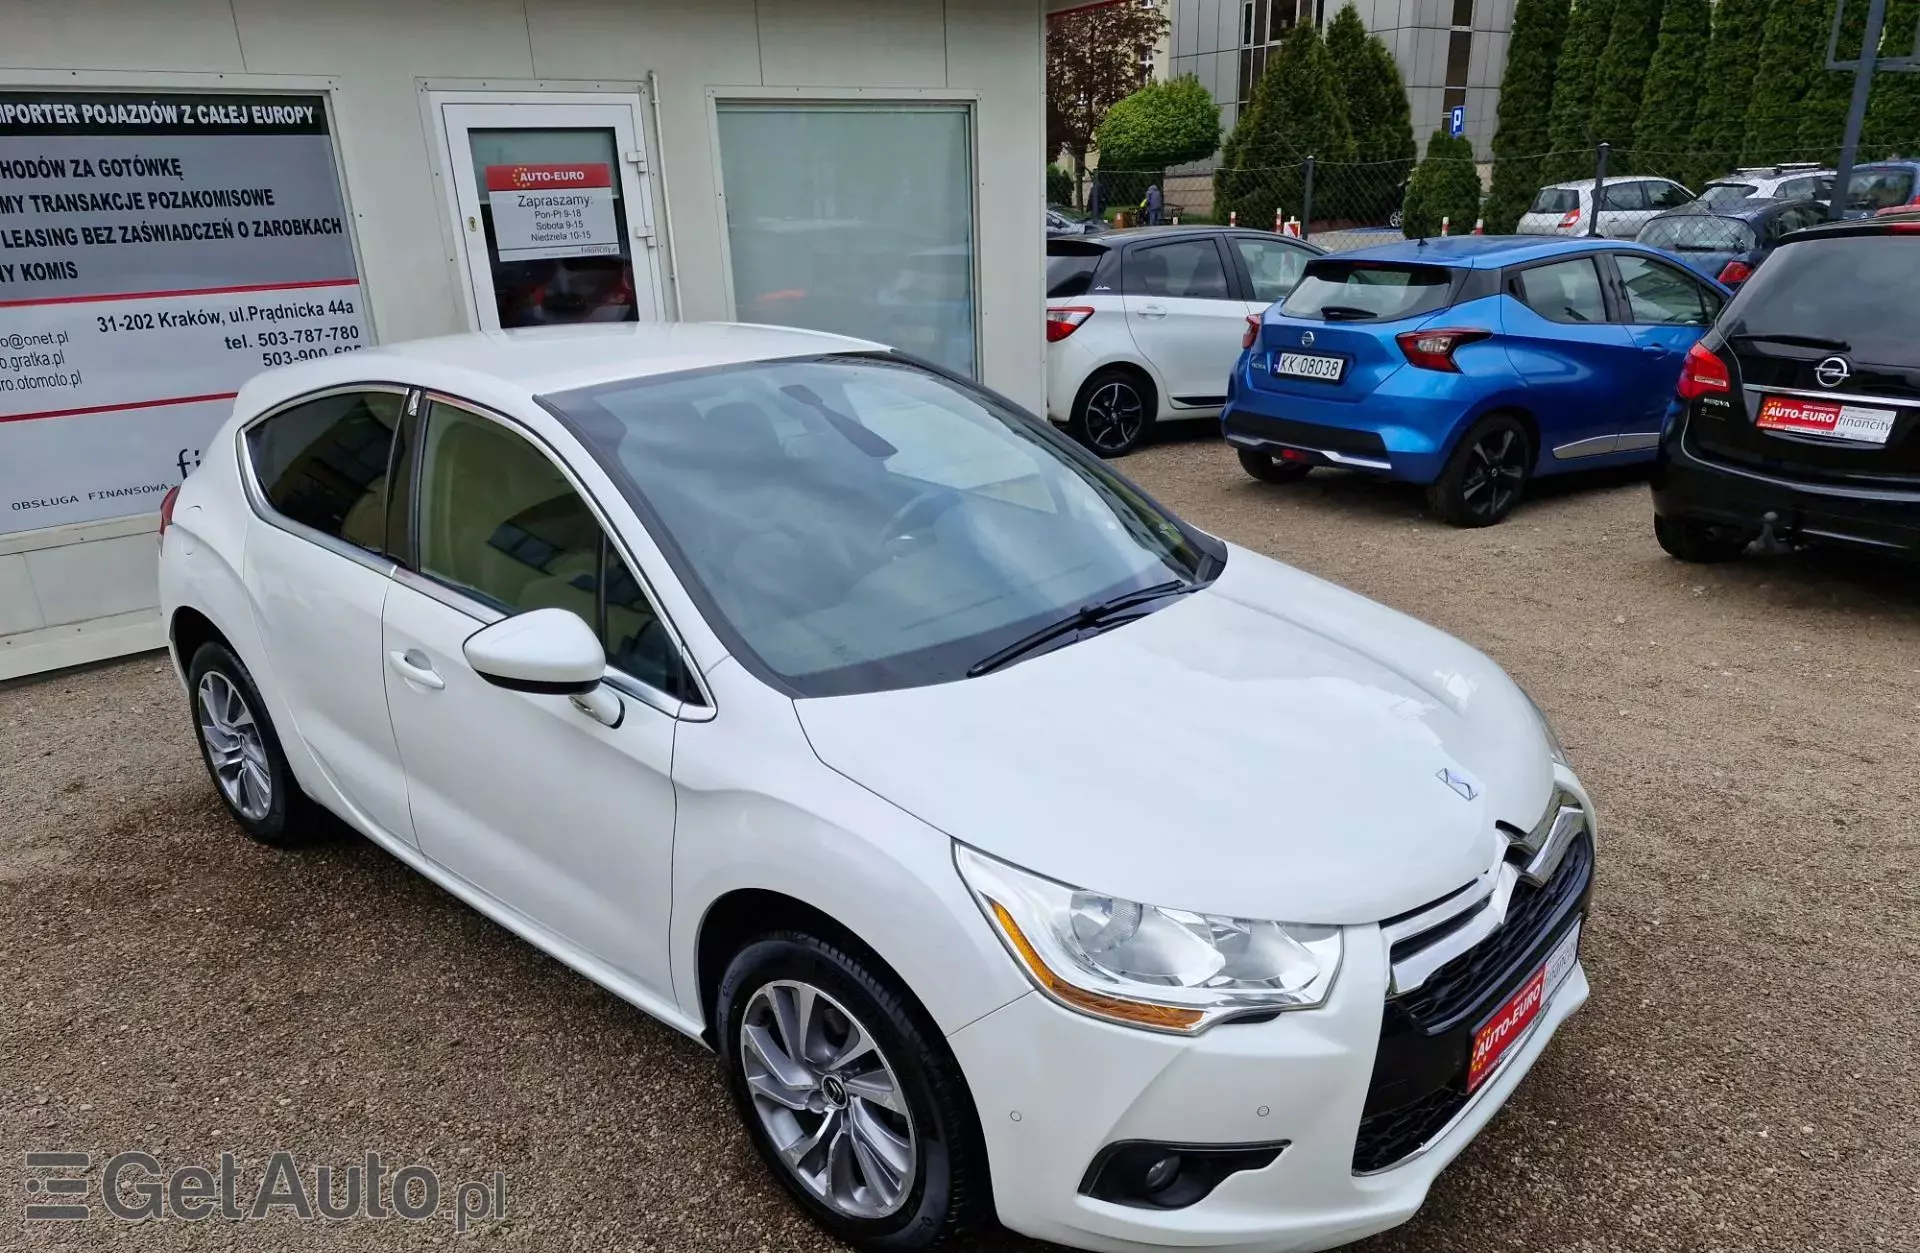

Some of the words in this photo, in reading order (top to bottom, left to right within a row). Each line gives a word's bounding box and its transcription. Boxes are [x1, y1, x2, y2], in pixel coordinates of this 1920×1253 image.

[81, 100, 178, 124] POJAZDÓW
[180, 105, 195, 124] Z
[197, 105, 249, 124] CAŁEJ
[252, 106, 314, 124] EUROPY
[1452, 109, 1462, 132] P
[0, 155, 66, 179] HODÓW
[69, 159, 96, 178] ZA
[99, 154, 184, 181] GOTÓWKĘ
[520, 171, 585, 182] AUTO-EURO
[28, 192, 145, 213] TRANSAKCJE
[147, 188, 275, 210] POZAKOMISOWE
[534, 210, 562, 219] Pon-Pt
[563, 209, 582, 218] 9-18
[535, 221, 564, 231] Sobota
[565, 220, 584, 229] 9-15
[0, 227, 79, 249] LEASING
[81, 226, 117, 245] BEZ
[118, 217, 235, 244] ZAŚWIADCZEŃ
[237, 220, 250, 239] O
[252, 217, 343, 238] ZAROBKACH
[530, 231, 567, 242] Niedziela
[569, 230, 592, 240] 10-15
[20, 260, 79, 282] KOMIS
[96, 313, 155, 333] 31-202
[157, 308, 226, 328] Kraków,
[229, 301, 326, 324] ul.Prądnicka
[328, 299, 355, 316] 44a
[0, 330, 69, 350] o@onet.pl
[224, 334, 254, 350] tel.
[257, 325, 360, 347] 503-787-780
[1281, 355, 1298, 373] KK
[1300, 357, 1339, 377] 08038
[0, 369, 83, 391] ro.otomoto.pl
[1767, 406, 1835, 423] AUTO-EURO
[1838, 413, 1893, 433] financity
[11, 495, 80, 511] OBSŁUGA
[88, 482, 169, 501] FINANSOWA
[1475, 983, 1541, 1062] AUTO-EURO
